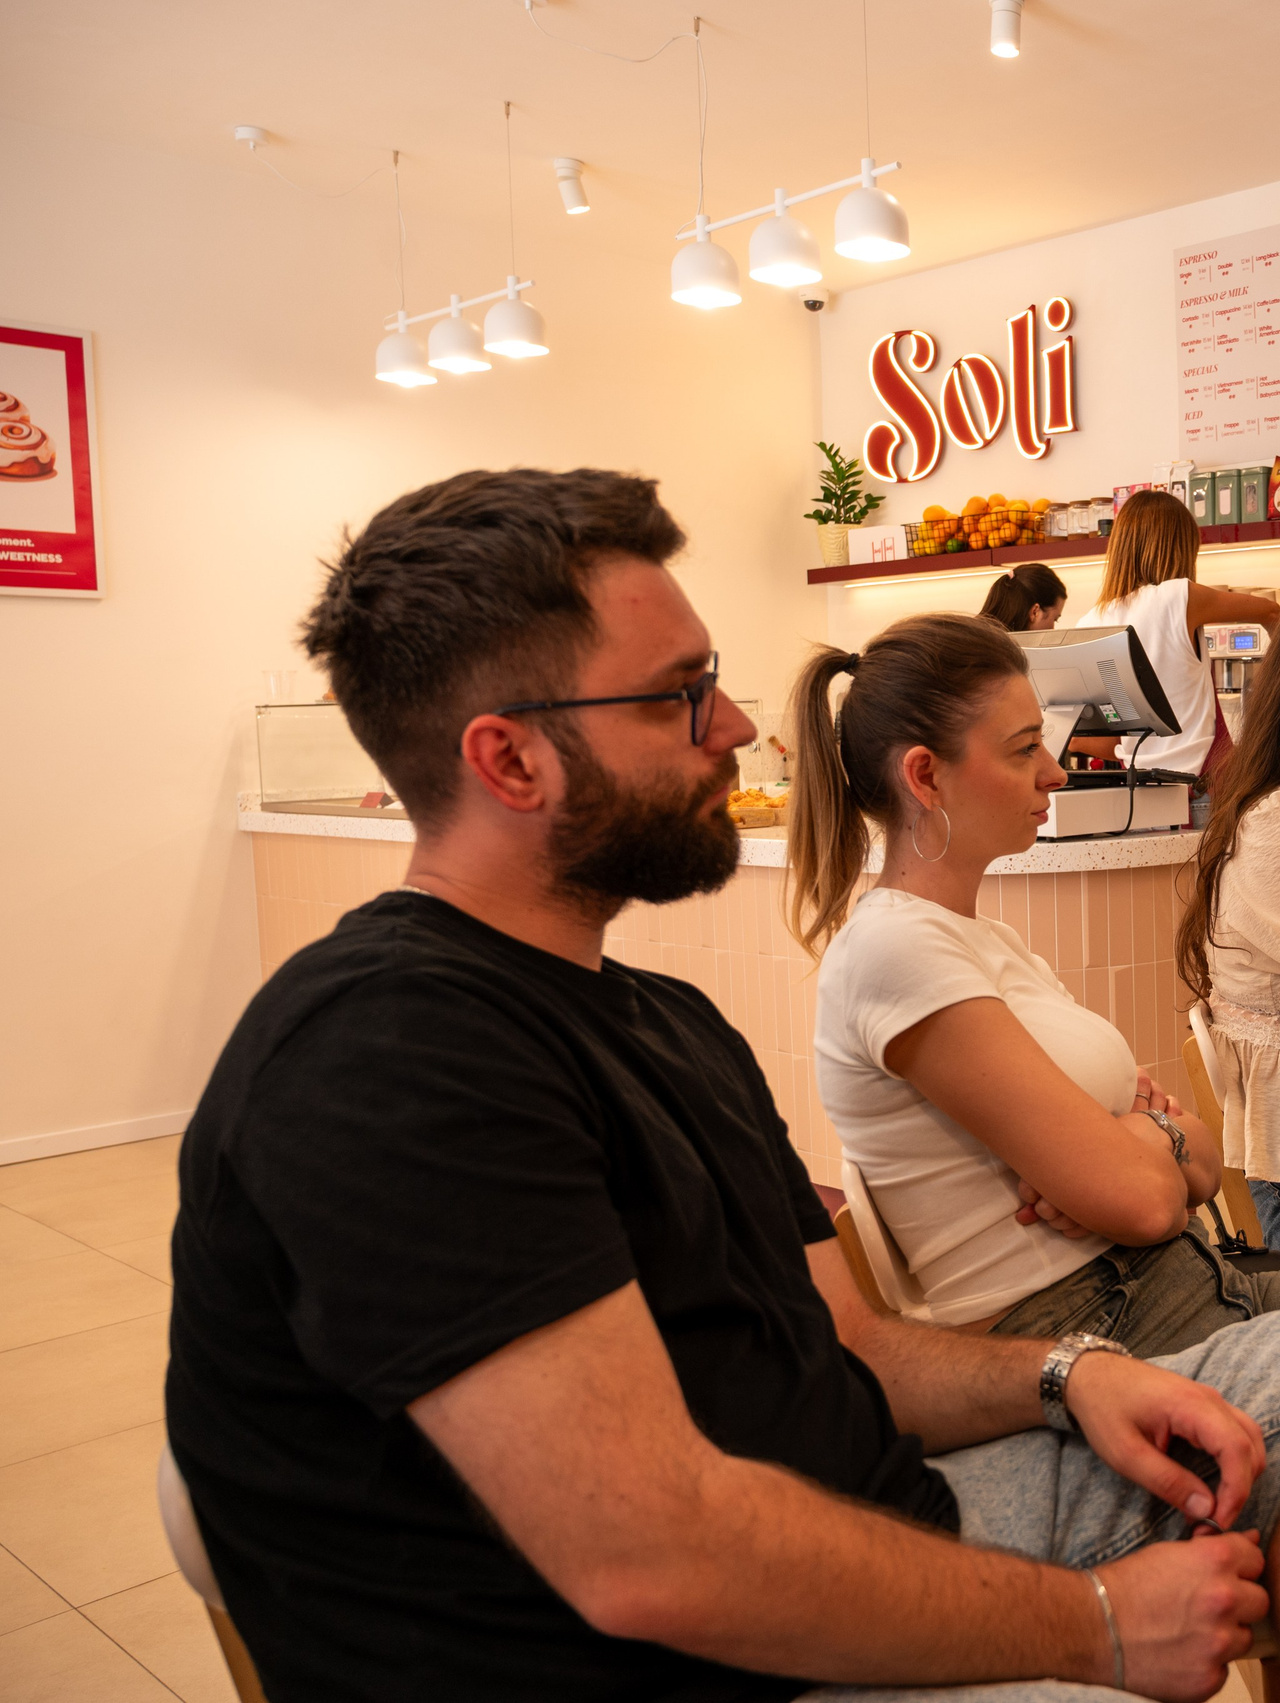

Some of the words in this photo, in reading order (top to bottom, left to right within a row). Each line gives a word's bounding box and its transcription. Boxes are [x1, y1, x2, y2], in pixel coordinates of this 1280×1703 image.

[1179, 250, 1218, 267] ESPRESSO
[1180, 292, 1218, 309] ESPRESSO
[1220, 290, 1227, 300] &
[1228, 286, 1249, 298] MILK
[1215, 306, 1241, 316] Cappuccino
[1183, 364, 1218, 378] SPECIALS
[863, 296, 1078, 483] Soli
[1185, 410, 1203, 421] ICED
